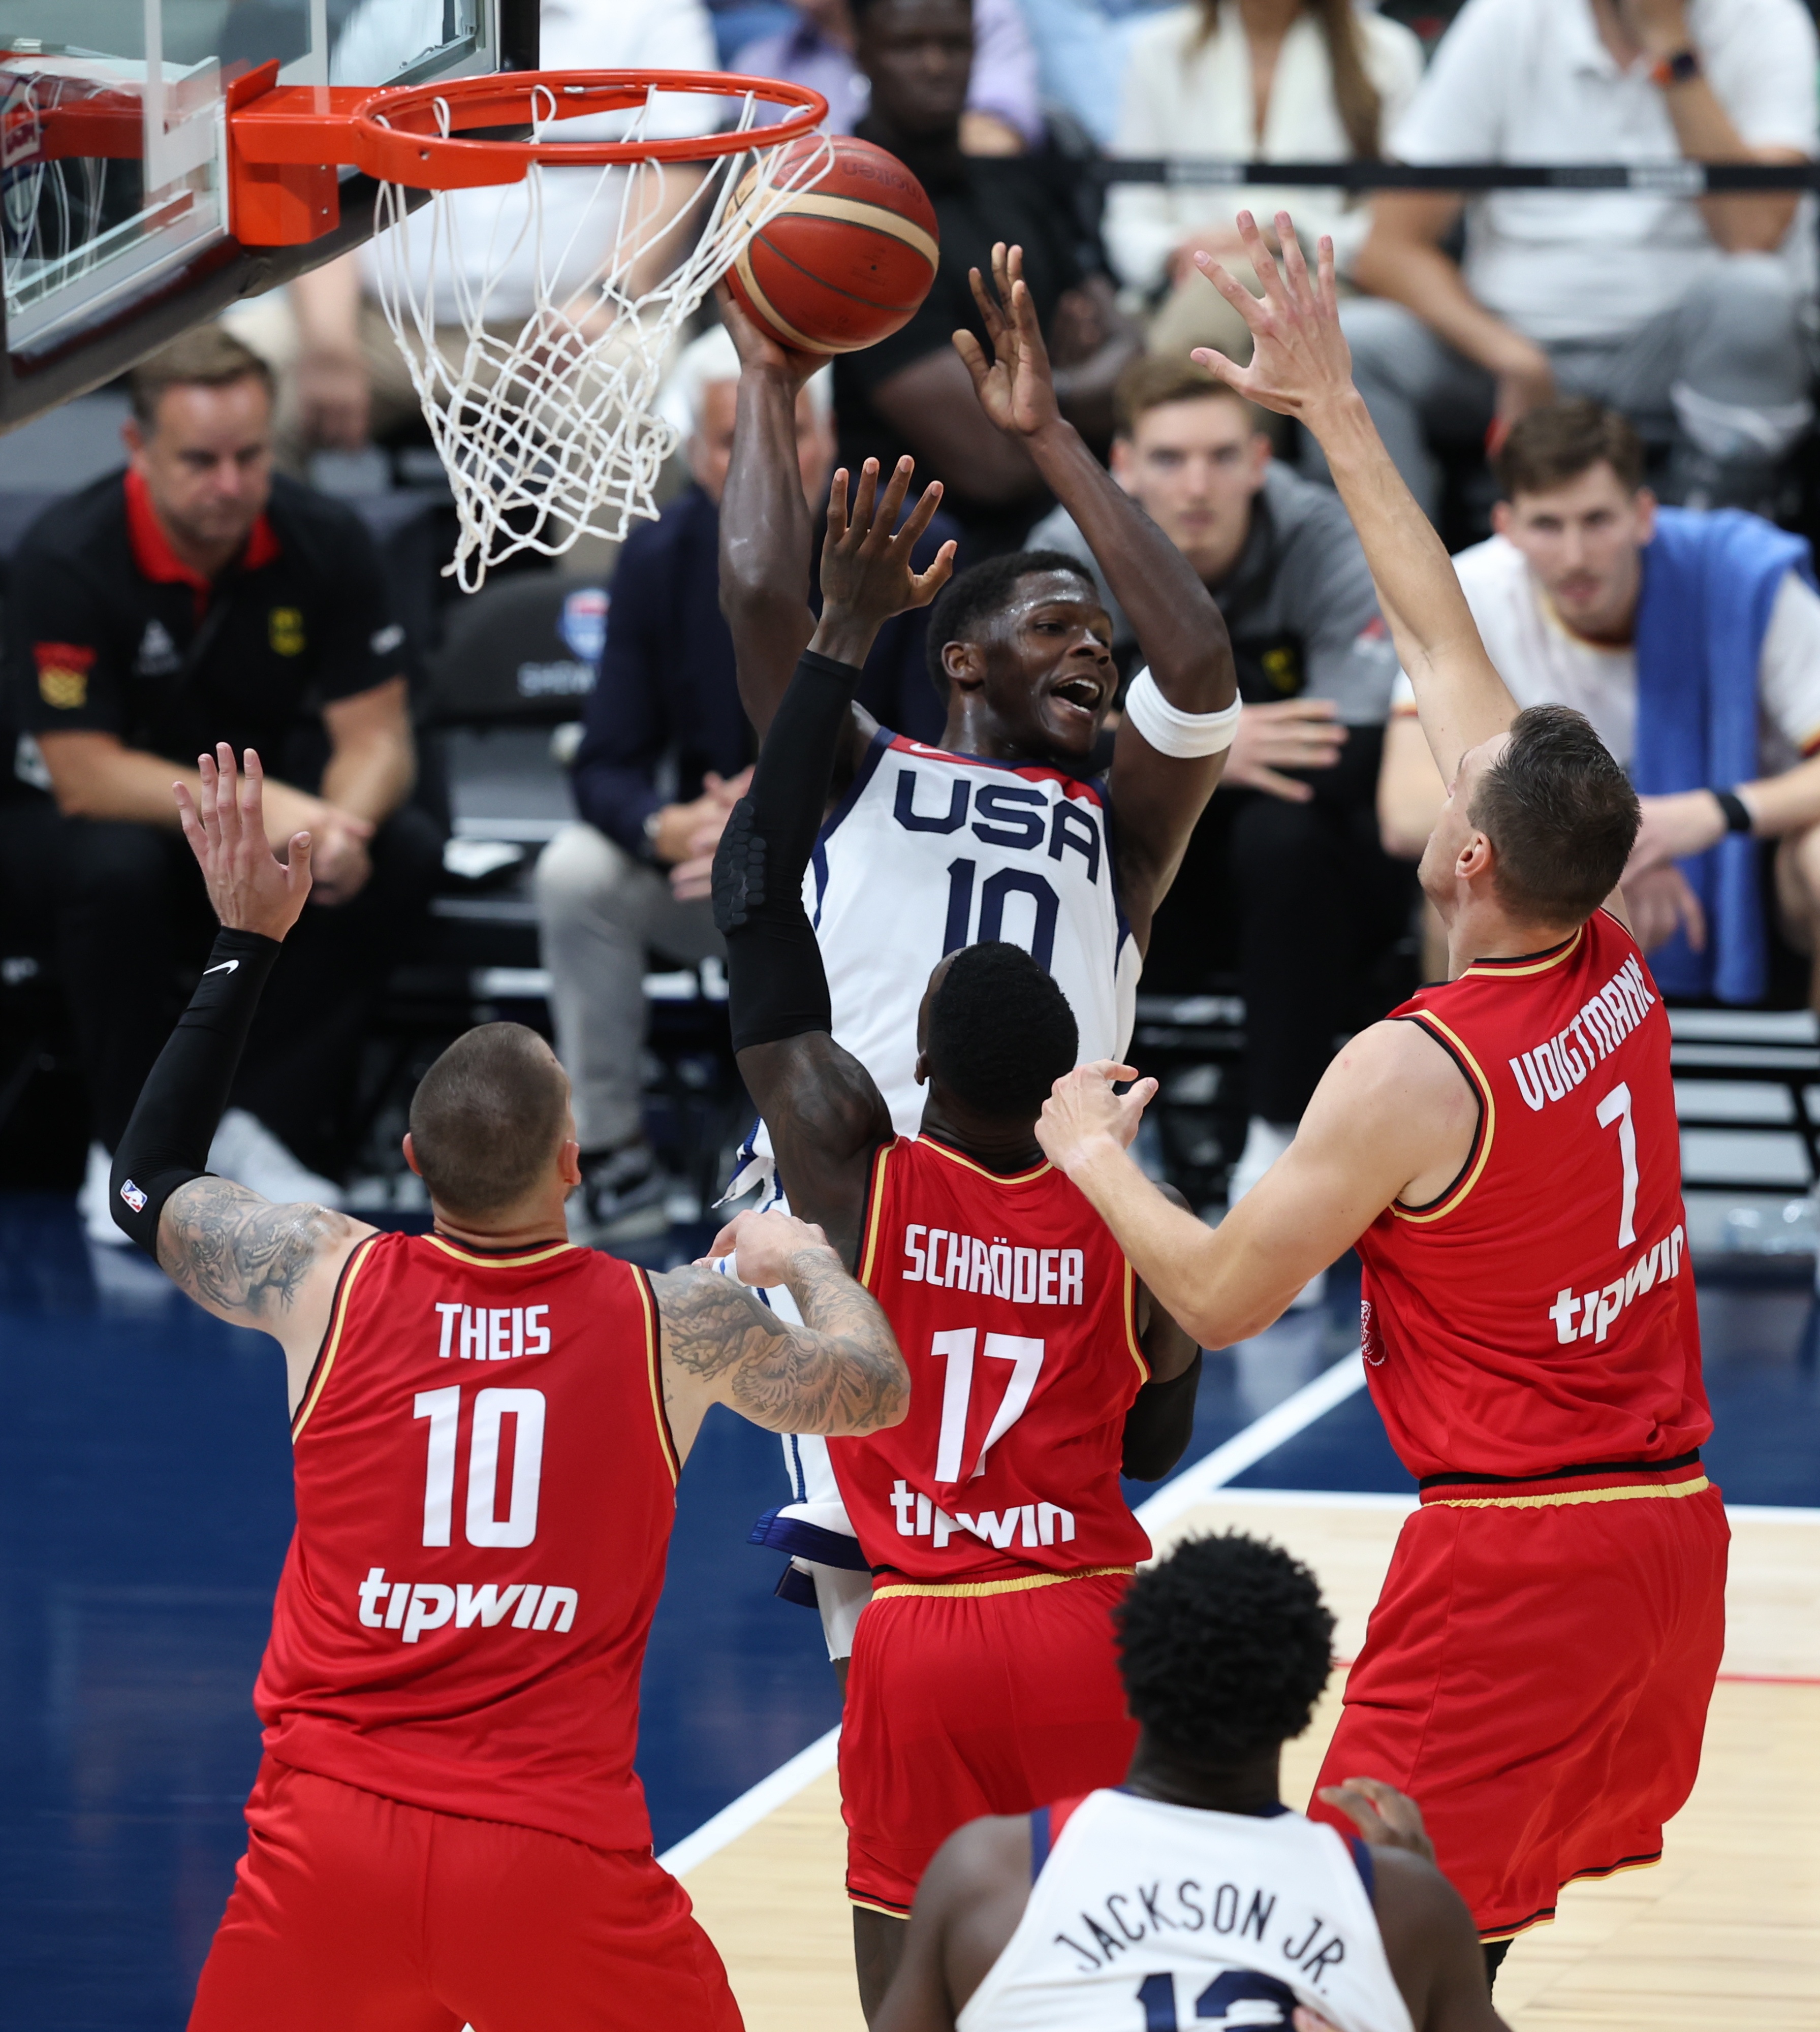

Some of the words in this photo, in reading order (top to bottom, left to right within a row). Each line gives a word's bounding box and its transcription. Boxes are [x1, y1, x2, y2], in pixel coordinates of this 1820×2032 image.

[893, 769, 1101, 886] USA
[942, 858, 1060, 976] 10
[1509, 952, 1656, 1112] VOIGTMANN
[1595, 1081, 1639, 1250] 7
[902, 1224, 1084, 1306] SCHRÖDER
[1549, 1224, 1685, 1345] tipwin
[435, 1302, 551, 1361] THEIS
[930, 1326, 1045, 1484] 17
[413, 1384, 546, 1548] 10
[358, 1567, 579, 1643] tipwin
[1054, 1879, 1276, 1973] JACKSON
[1282, 1916, 1345, 1994] JR.
